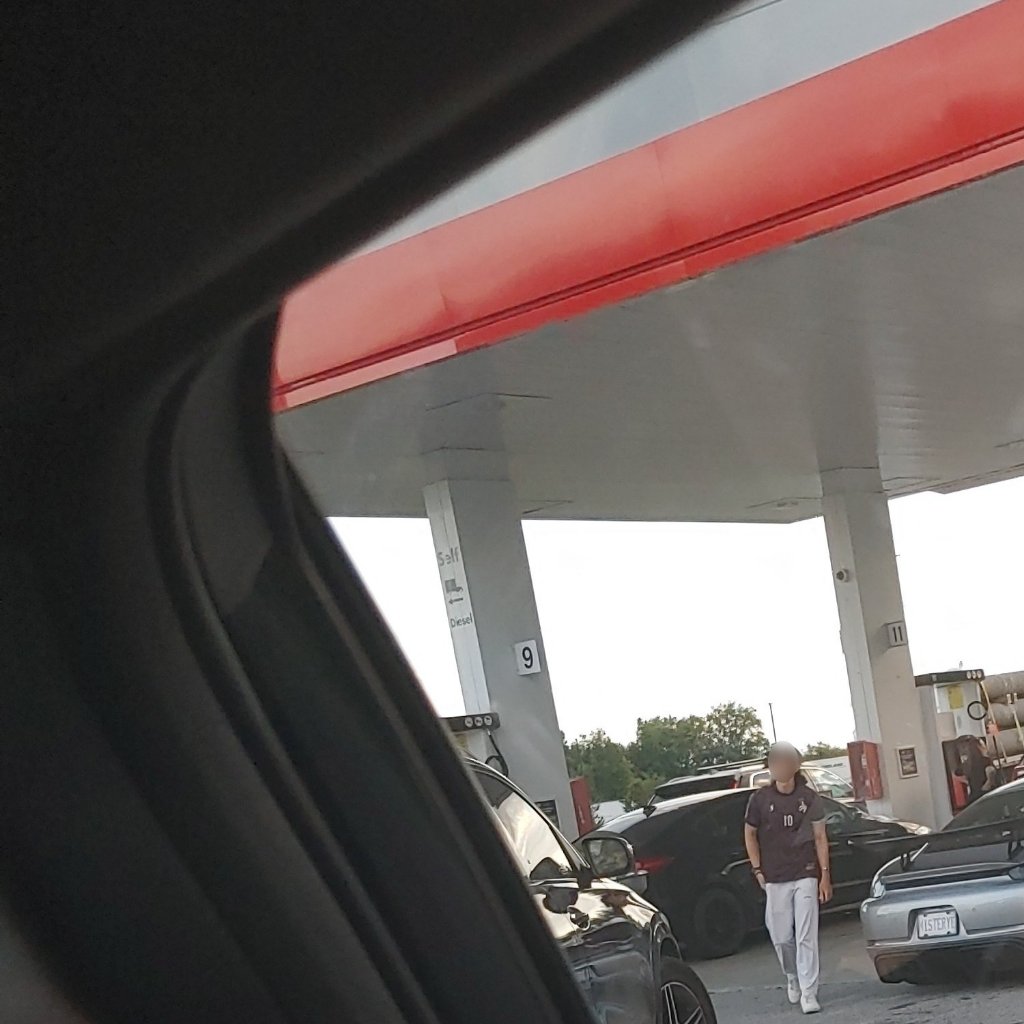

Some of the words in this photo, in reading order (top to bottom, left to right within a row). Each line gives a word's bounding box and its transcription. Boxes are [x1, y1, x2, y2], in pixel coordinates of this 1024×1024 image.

[437, 547, 460, 567] Self
[450, 612, 474, 628] Diesel
[892, 625, 904, 643] 11
[521, 646, 534, 669] 9
[783, 814, 794, 827] 10
